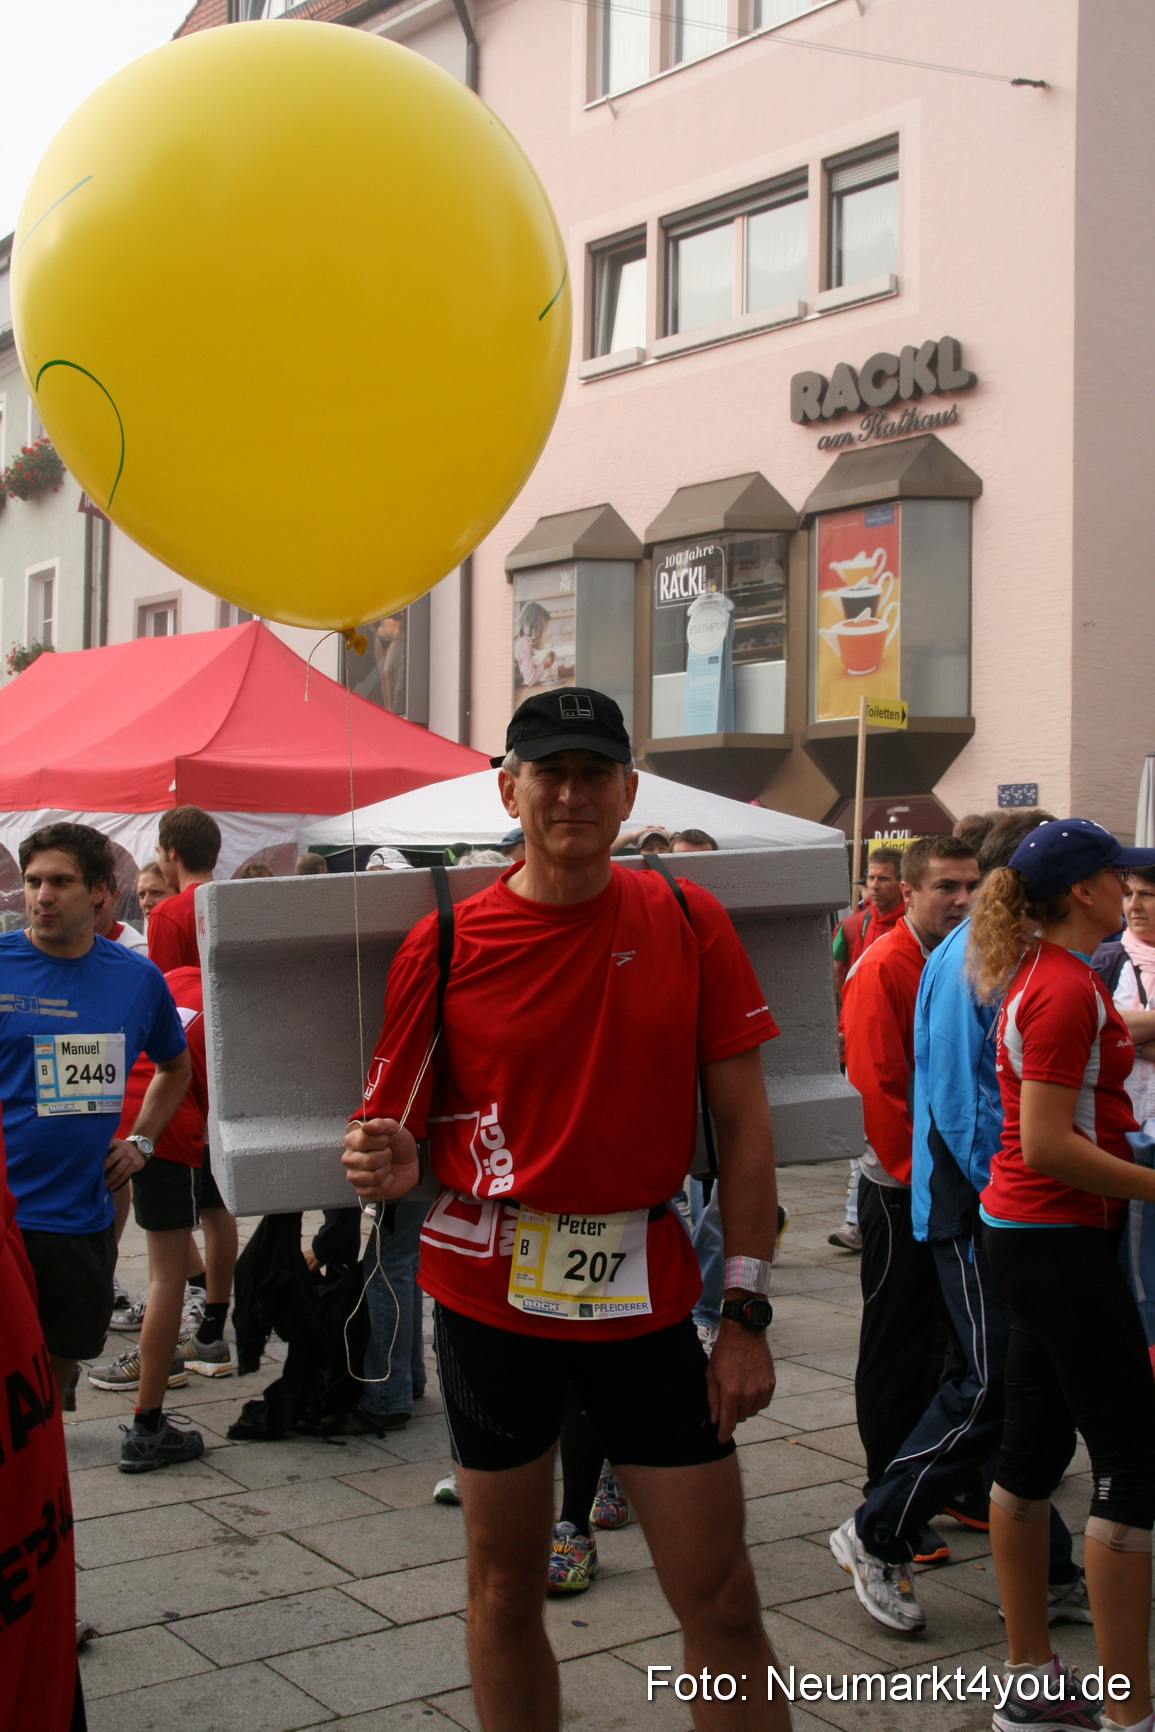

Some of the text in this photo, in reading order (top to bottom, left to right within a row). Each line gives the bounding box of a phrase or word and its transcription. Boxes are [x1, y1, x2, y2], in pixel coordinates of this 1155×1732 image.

[790, 335, 978, 426] RACKL
[817, 403, 959, 450] am Rathaus
[664, 545, 715, 569] 100 Jahre
[660, 566, 706, 600] RACKL
[61, 1041, 100, 1055] Manuel
[41, 1065, 48, 1075] B
[65, 1063, 116, 1085] 2449
[480, 1102, 514, 1196] BÖGL
[557, 1213, 606, 1236] Peter
[520, 1239, 529, 1255] B
[564, 1249, 627, 1283] 207
[523, 1299, 560, 1311] BOCK
[594, 1302, 649, 1312] PFLEIDERER
